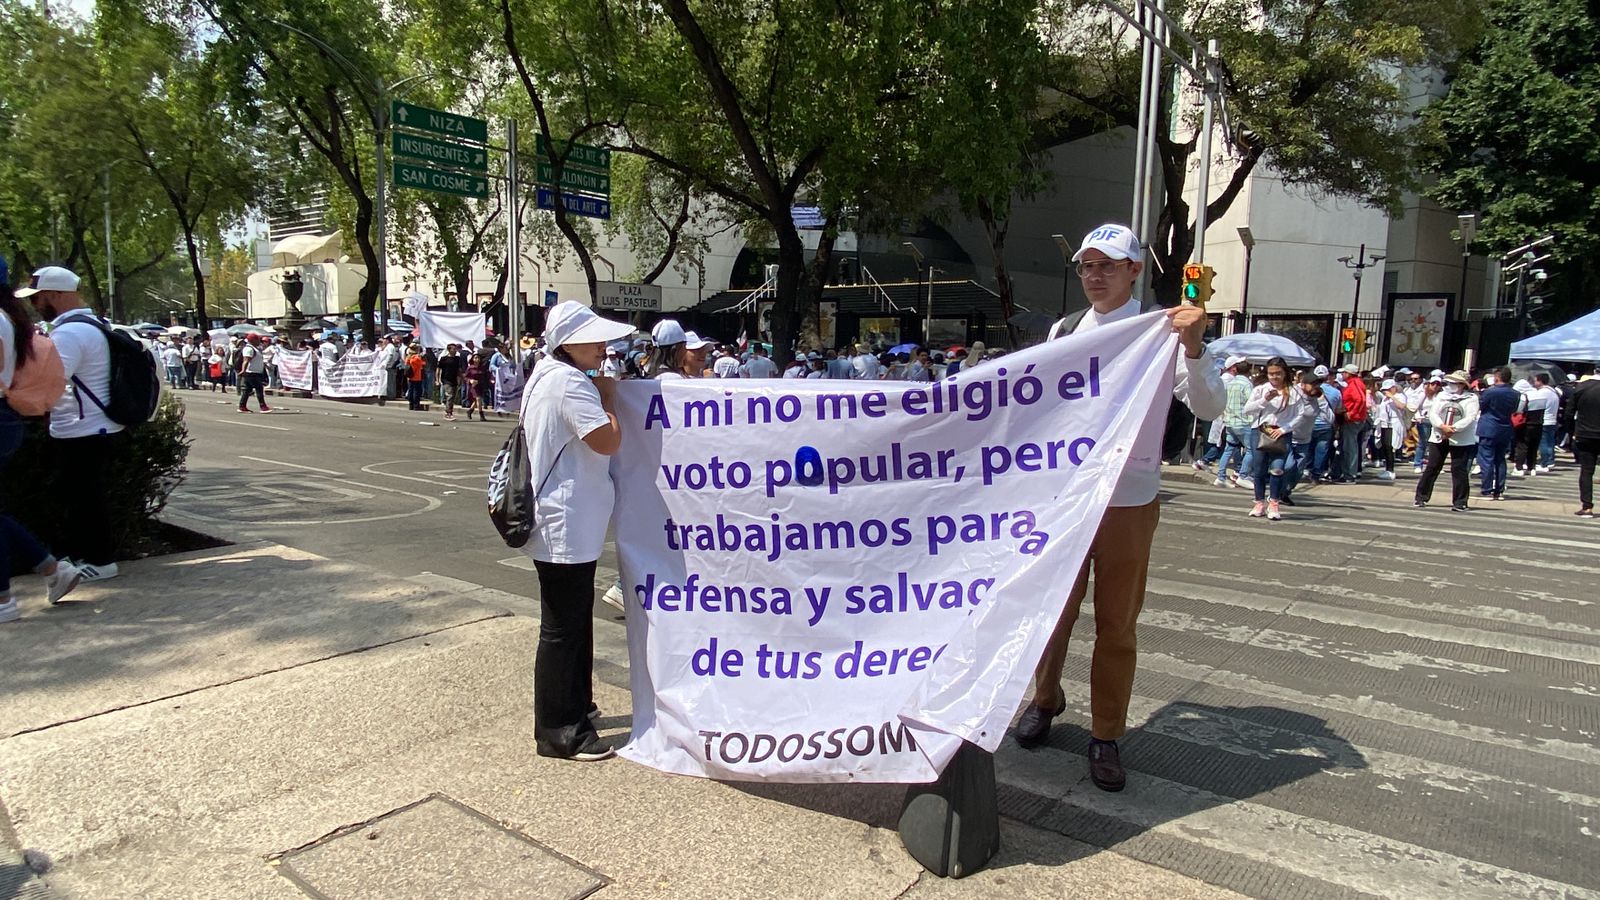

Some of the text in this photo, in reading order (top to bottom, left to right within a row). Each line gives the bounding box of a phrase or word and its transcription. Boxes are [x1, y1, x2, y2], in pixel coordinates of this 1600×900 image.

[429, 114, 466, 134] NIZA
[400, 138, 470, 163] INSURGENTES
[401, 168, 471, 192] SAN COSME
[543, 167, 597, 188] VIALONGIN
[568, 198, 580, 211] DEL
[582, 201, 597, 214] ARTE
[1087, 229, 1120, 244] PJF
[601, 296, 658, 309] LUIS PASTEUR
[619, 285, 642, 296] PLAZA
[644, 356, 1101, 430] A mi no me eligió el
[661, 436, 1097, 498] voto popular, pero
[664, 512, 913, 561] trabajamos
[926, 510, 1036, 555] para
[634, 573, 793, 616] defensa
[804, 586, 832, 627] y
[691, 637, 949, 680] de tus dere
[698, 721, 918, 764] TODOSSOM
